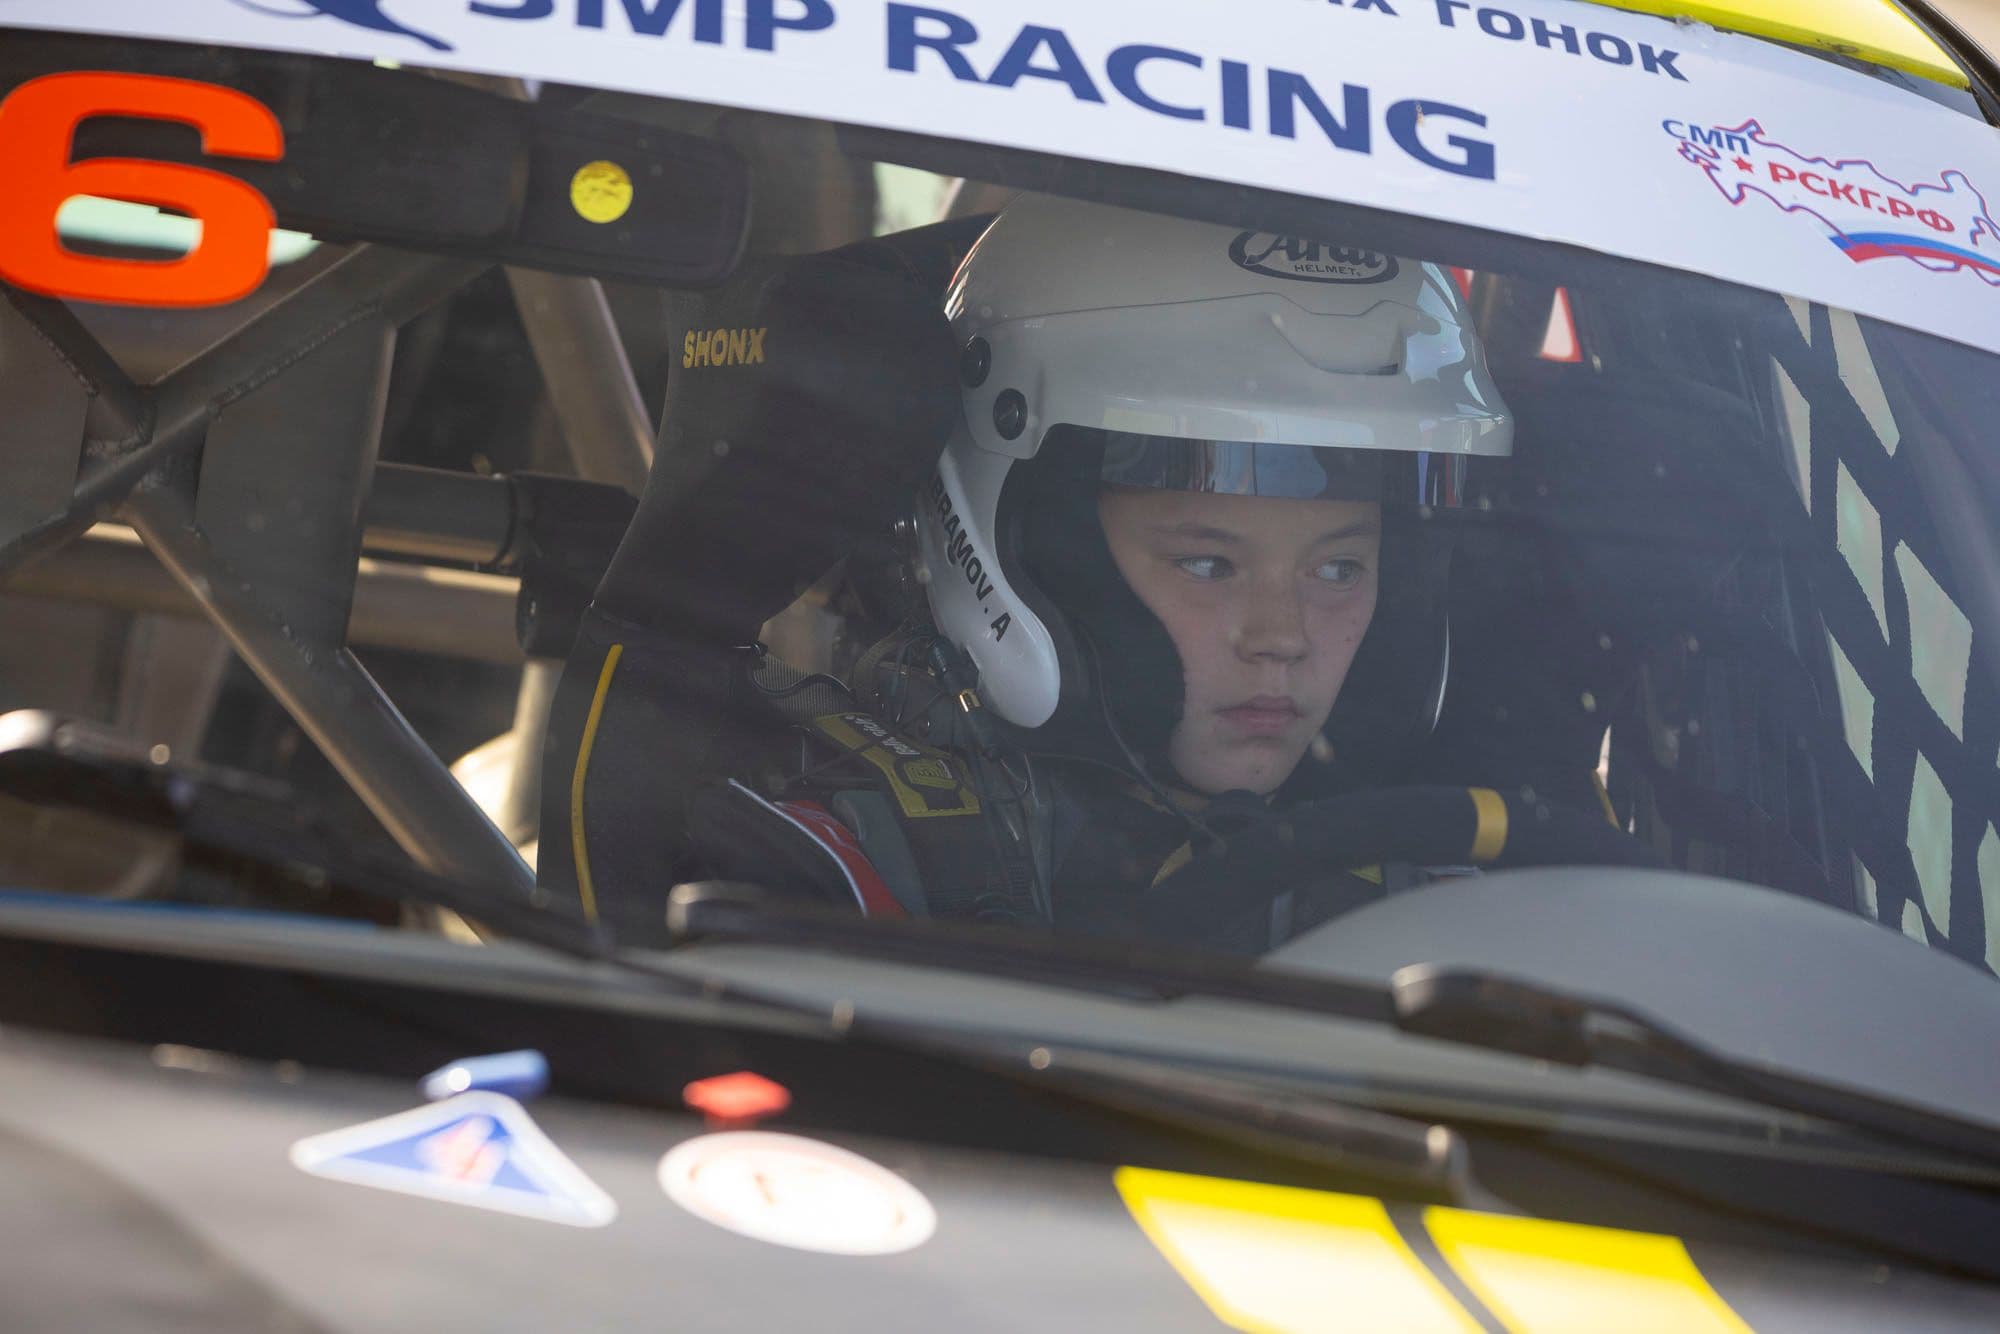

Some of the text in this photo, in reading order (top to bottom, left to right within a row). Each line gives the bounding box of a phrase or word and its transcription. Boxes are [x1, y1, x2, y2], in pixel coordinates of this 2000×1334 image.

[1435, 0, 1690, 82] ГОНОК
[467, 0, 1497, 181] MP RACING
[1661, 118, 1750, 155] СМП
[0, 70, 285, 309] 6
[1767, 161, 1956, 232] РСКГ.РФ
[683, 328, 767, 368] SHONX
